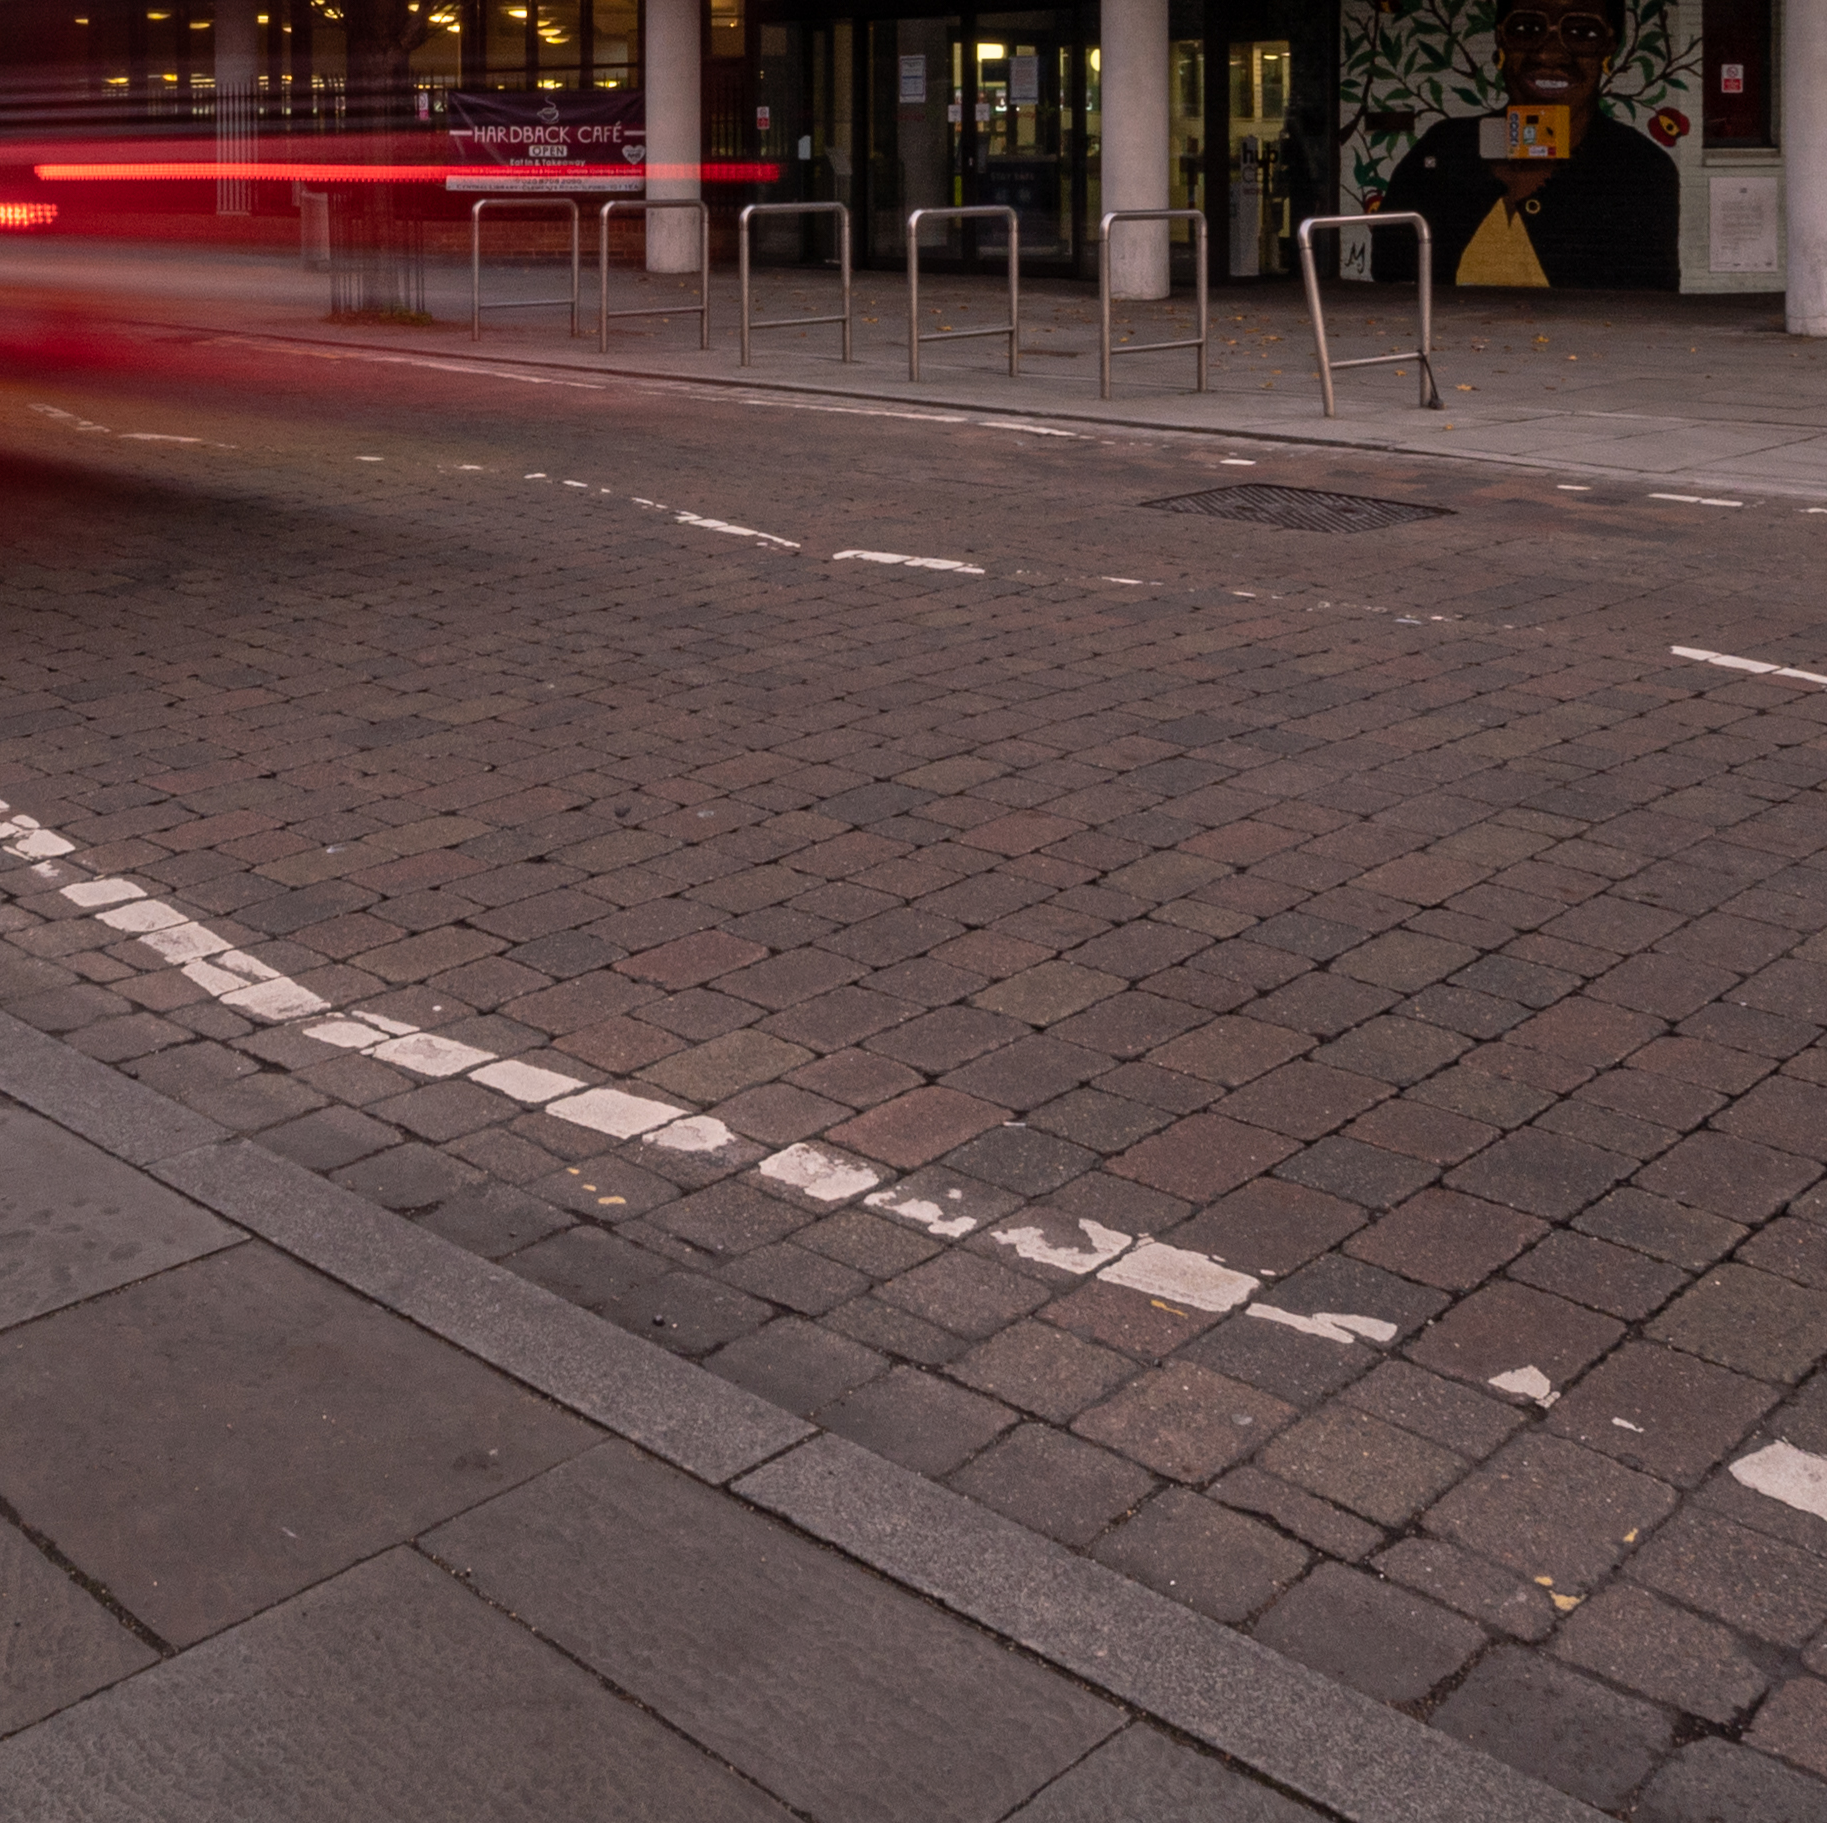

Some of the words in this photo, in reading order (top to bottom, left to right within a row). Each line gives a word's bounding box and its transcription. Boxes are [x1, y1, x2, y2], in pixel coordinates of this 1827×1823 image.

[473, 125, 571, 144] HARDBACK
[577, 120, 622, 144] CAFÉ
[531, 146, 565, 156] OPEN
[1242, 142, 1279, 164] hub
[542, 158, 586, 167] Takeaway
